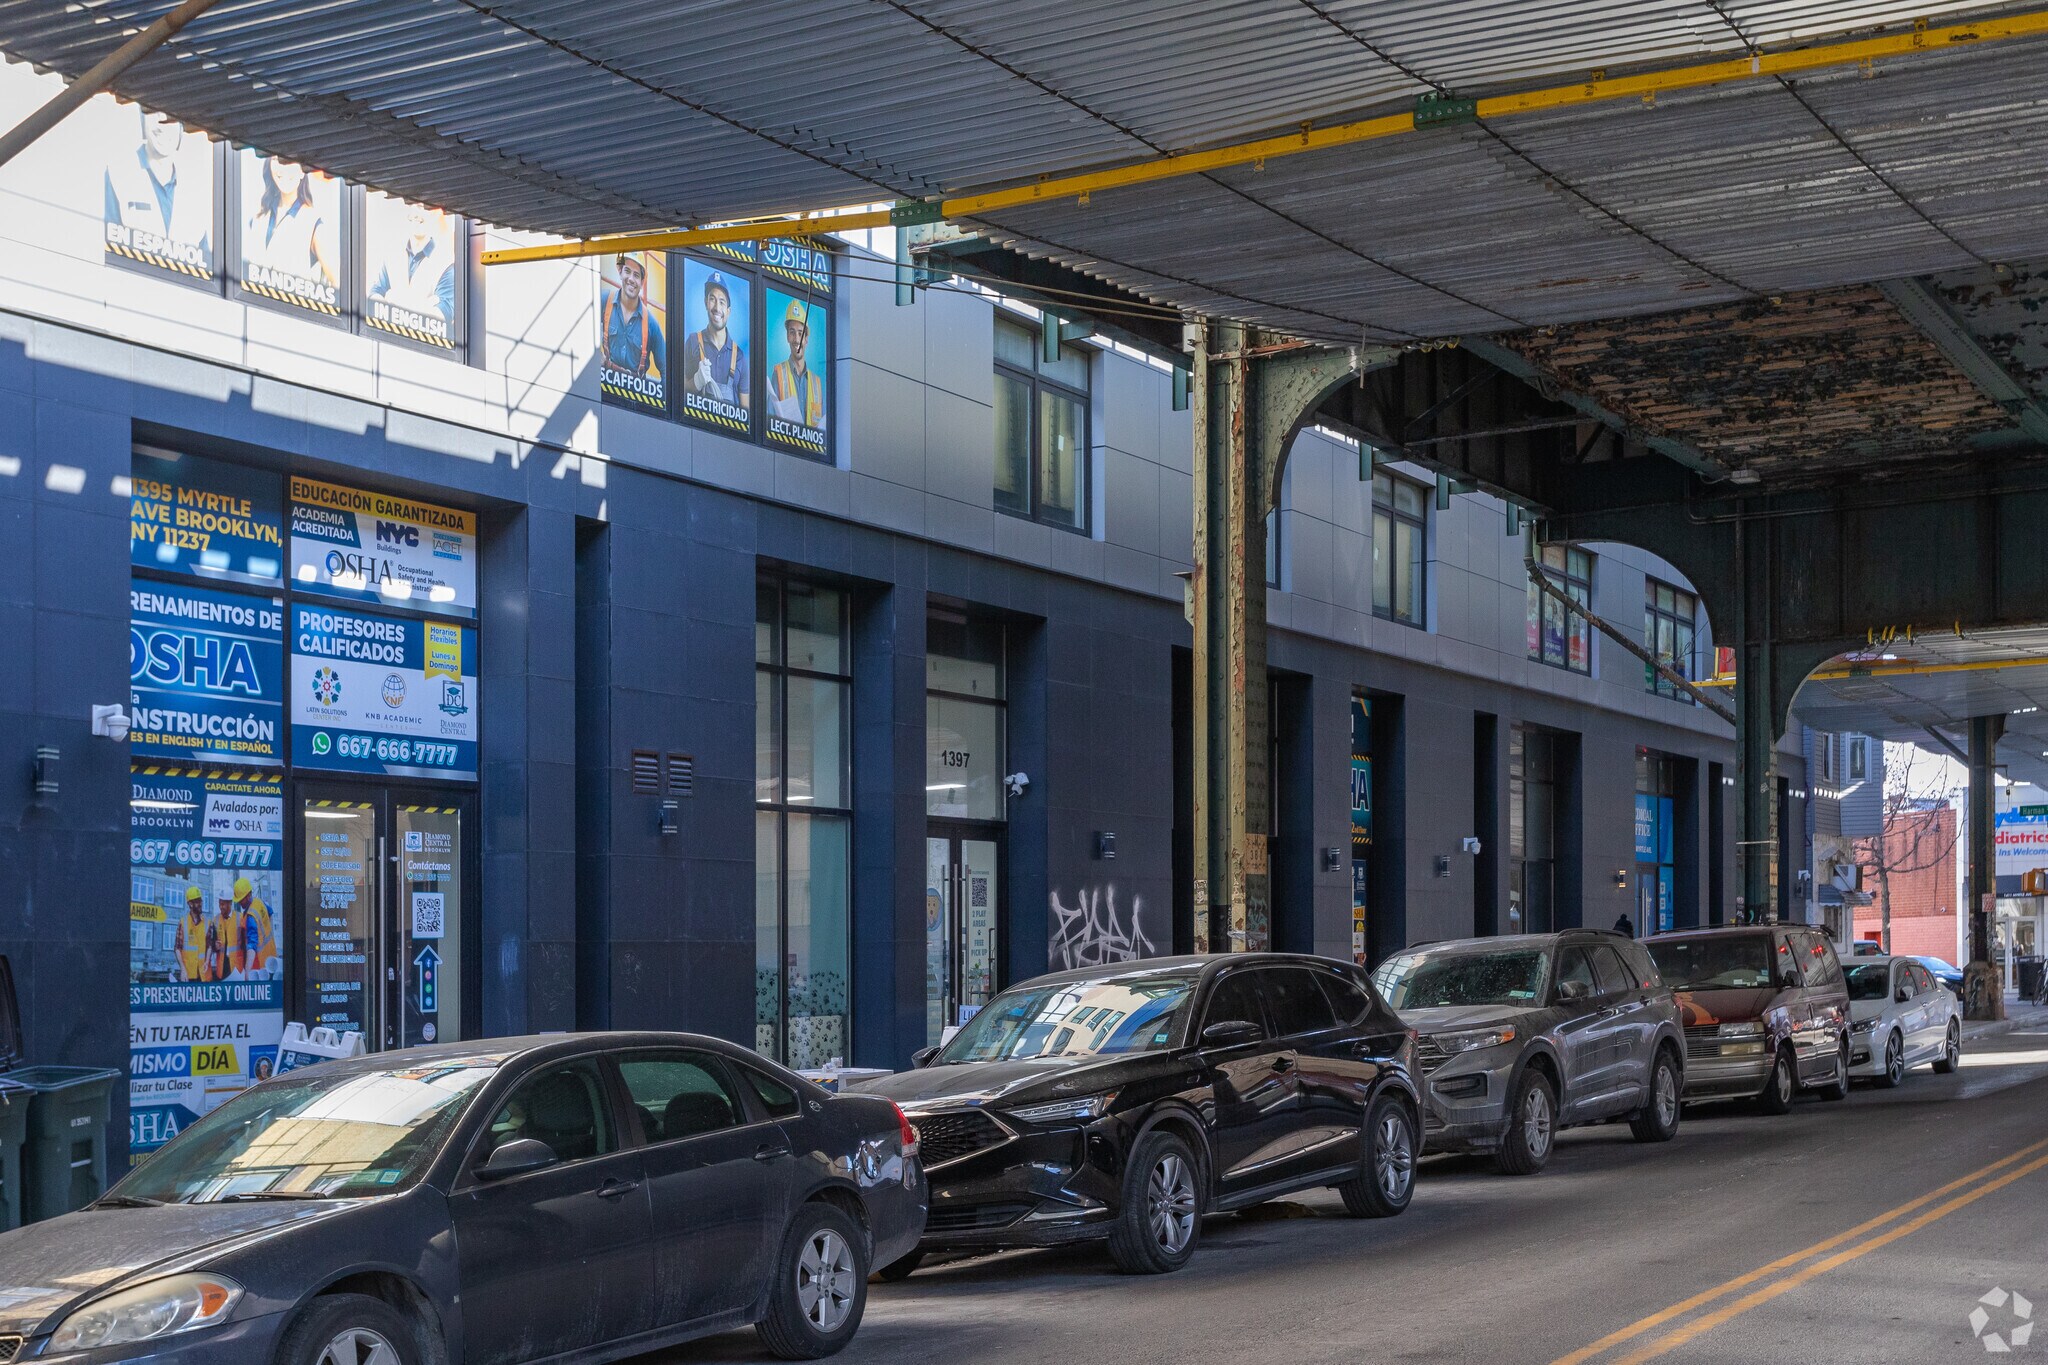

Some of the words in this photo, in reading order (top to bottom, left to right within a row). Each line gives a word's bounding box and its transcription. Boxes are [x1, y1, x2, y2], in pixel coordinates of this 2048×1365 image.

[107, 222, 131, 244] EN
[132, 227, 207, 269] ESPAÑOL
[764, 237, 828, 282] OSHA
[248, 264, 336, 304] BANDERAS
[374, 301, 389, 320] IN
[391, 305, 447, 338] ENGLISH
[601, 366, 664, 398] SCAFFOLDS
[686, 393, 748, 422] ELECTRICIDAD
[770, 418, 791, 436] LECT.
[792, 425, 824, 445] PLANOS
[131, 478, 172, 502] 1395
[178, 487, 252, 518] MYRTLE
[292, 481, 371, 512] EDUCACIÓN
[375, 499, 465, 530] GARANTIZADA
[131, 500, 170, 523] AVE
[176, 508, 283, 547] BROOKLYN,
[292, 506, 345, 526] ACADEMIA
[131, 521, 159, 543] NY
[163, 527, 210, 551] 11237
[292, 520, 354, 542] ACREDITADA
[376, 520, 420, 548] NYC
[376, 543, 402, 555] Buildings
[398, 564, 433, 577] Occupational
[398, 572, 415, 583] Safety
[417, 576, 427, 584] and
[260, 611, 282, 631] DE
[300, 611, 405, 643] PROFESORES
[430, 626, 457, 637] Horarios
[430, 635, 458, 645] Flexibles
[300, 633, 404, 664] CALIFICADOS
[432, 651, 450, 661] Lunes
[429, 661, 458, 672] Domingo
[446, 694, 462, 707] DC
[306, 706, 320, 714] LATIN
[321, 708, 348, 717] SOLUTIONS
[365, 713, 381, 721] KNB
[384, 714, 423, 724] ACADEMIC
[132, 707, 274, 741] NSTRUCCIÓN
[440, 719, 467, 729] DIAMOND
[440, 727, 467, 736] CENTRAL
[131, 732, 143, 742] ES
[146, 733, 159, 743] EN
[162, 735, 203, 748] ENGLISH
[206, 738, 213, 748] Y
[215, 739, 228, 750] EN
[230, 739, 273, 754] ESPAÑOL
[337, 733, 459, 766] 667-666-7777
[941, 749, 970, 768] 1397
[132, 784, 193, 802] DIAMOND
[205, 782, 252, 793] CAPACITATE
[254, 784, 281, 794] AHORA
[212, 800, 257, 814] Avalados
[259, 803, 279, 816] por:
[132, 817, 194, 828] BROOKLYN
[209, 819, 230, 829] NYC
[131, 838, 273, 867] 667-666-7777
[408, 860, 451, 871] Contáctanos
[976, 910, 986, 918] PLAY
[144, 986, 222, 1004] PRESENCIALES
[225, 986, 231, 1002] Y
[234, 984, 271, 1001] ONLINE
[151, 1025, 169, 1042] TU
[174, 1024, 232, 1041] TARJETA
[236, 1023, 251, 1038] EL
[197, 1046, 229, 1071] DÍA
[155, 1081, 166, 1091] tu
[168, 1080, 193, 1091] Clase
